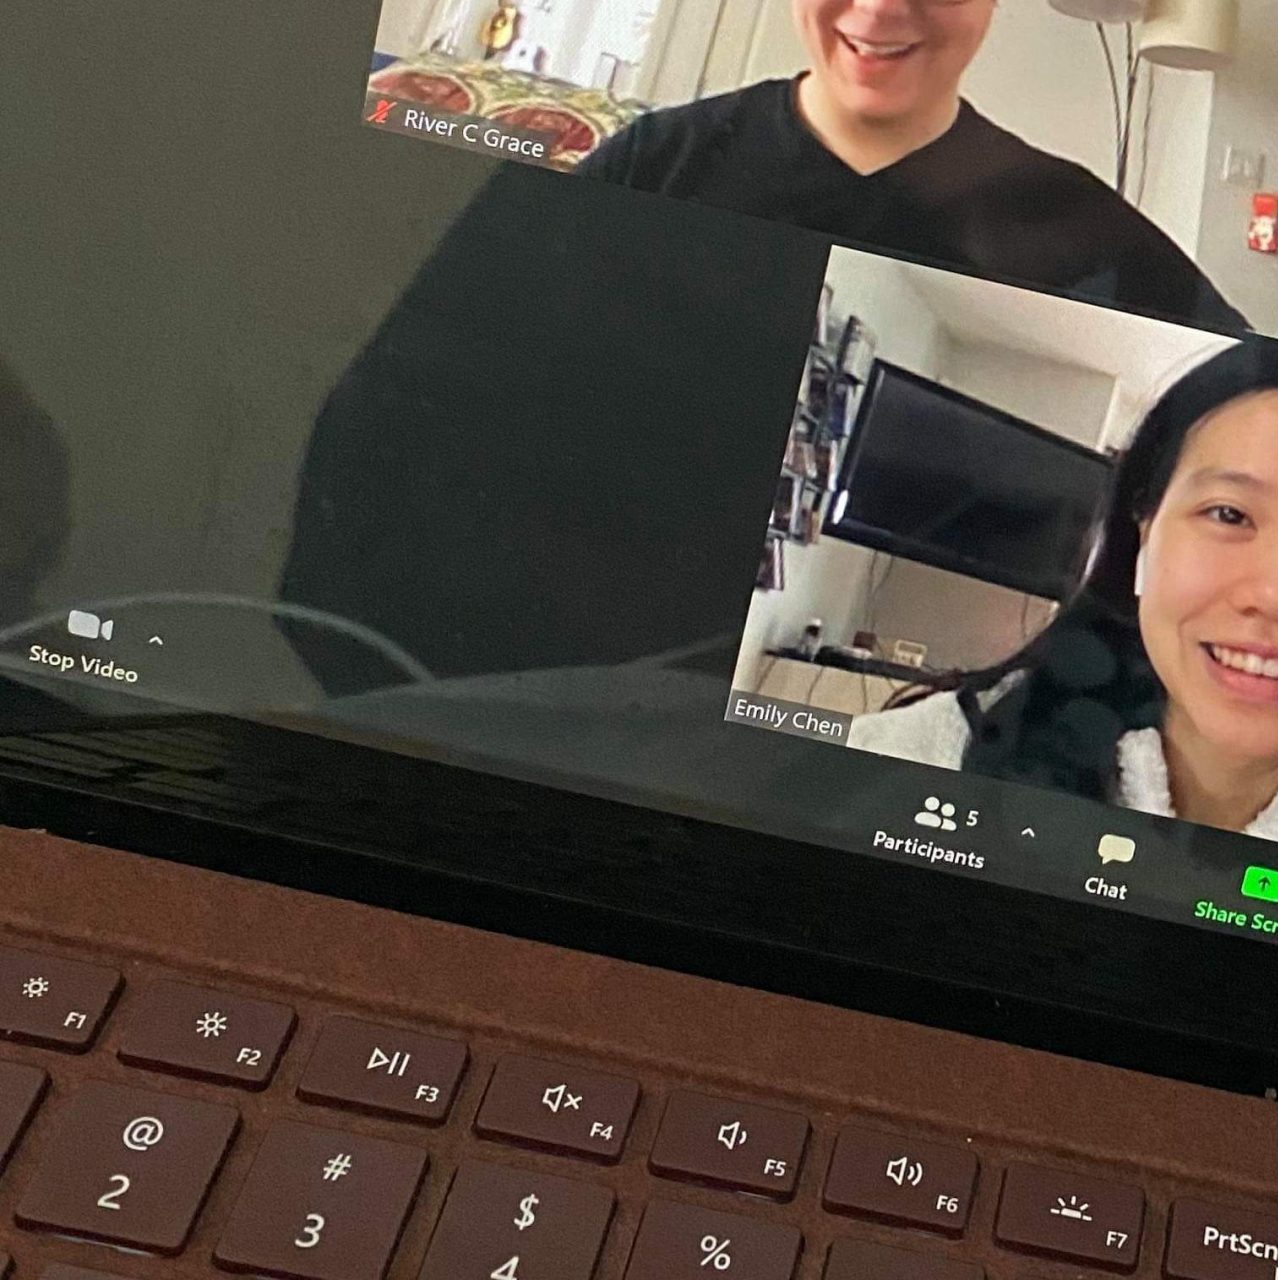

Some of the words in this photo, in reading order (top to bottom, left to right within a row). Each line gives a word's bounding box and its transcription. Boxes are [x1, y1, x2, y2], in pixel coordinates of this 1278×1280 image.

[404, 109, 457, 137] River
[462, 124, 478, 143] C
[483, 128, 545, 158] Grace
[29, 645, 75, 671] Stop
[80, 655, 139, 683] Video
[734, 699, 788, 727] Emily
[792, 712, 843, 737] Chen
[966, 809, 979, 827] 5
[872, 830, 985, 870] Participants
[1084, 876, 1128, 901] Chat
[1194, 900, 1247, 928] Share
[64, 1011, 87, 1030] F1
[236, 1048, 262, 1066] F2
[415, 1084, 440, 1103] F3
[122, 1116, 165, 1152] @
[589, 1122, 614, 1141] F4
[322, 1153, 353, 1183] #
[763, 1158, 787, 1178] F5
[97, 1174, 131, 1210] 2
[936, 1194, 959, 1214] F6
[513, 1194, 541, 1231] $
[294, 1214, 326, 1249] 3
[1105, 1230, 1128, 1250] F7
[1203, 1226, 1278, 1262] PrtScn
[700, 1235, 732, 1272] %
[490, 1257, 518, 1280] 4
